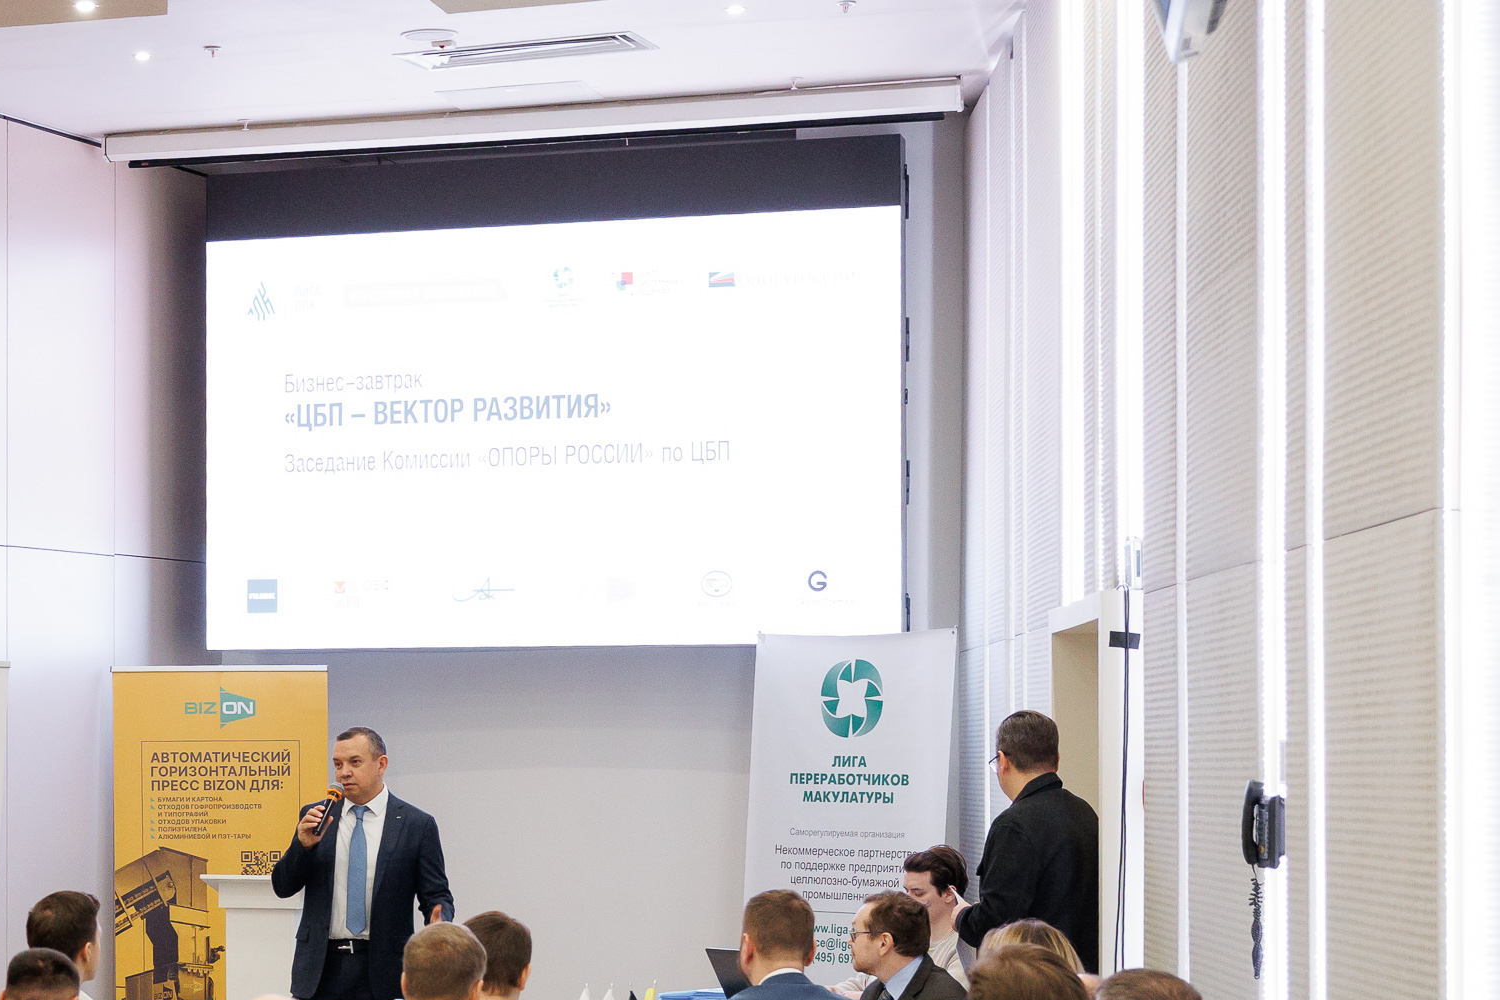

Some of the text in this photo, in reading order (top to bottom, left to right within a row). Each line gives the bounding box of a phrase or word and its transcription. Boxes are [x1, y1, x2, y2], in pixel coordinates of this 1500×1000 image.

[285, 402, 343, 431] «ЦБП
[373, 399, 464, 425] ВЕКТОР
[473, 393, 611, 421] РАЗВИТИЯ»
[284, 440, 730, 476] Заседание Комиссии «ОПОРЫ РОССИИ» по ЦБП
[150, 749, 291, 763] АВТОМАТИЧЕСКИЙ
[831, 755, 867, 768] ЛИГА
[150, 763, 291, 777] ГОРИЗОНТАЛЬНЫЙ
[151, 779, 284, 792] ПРЕСС BIZON ДЛЯ:
[789, 772, 910, 786] ПЕРЕРАБОТЧИКОВ
[802, 789, 894, 804] МАКУЛАТУРЫ
[789, 827, 905, 839] Саморегулируемая организация
[774, 844, 855, 859] Некоммерческое
[780, 861, 905, 874] по поддержке предприяти
[790, 875, 900, 889] целлюлозно-бумажной
